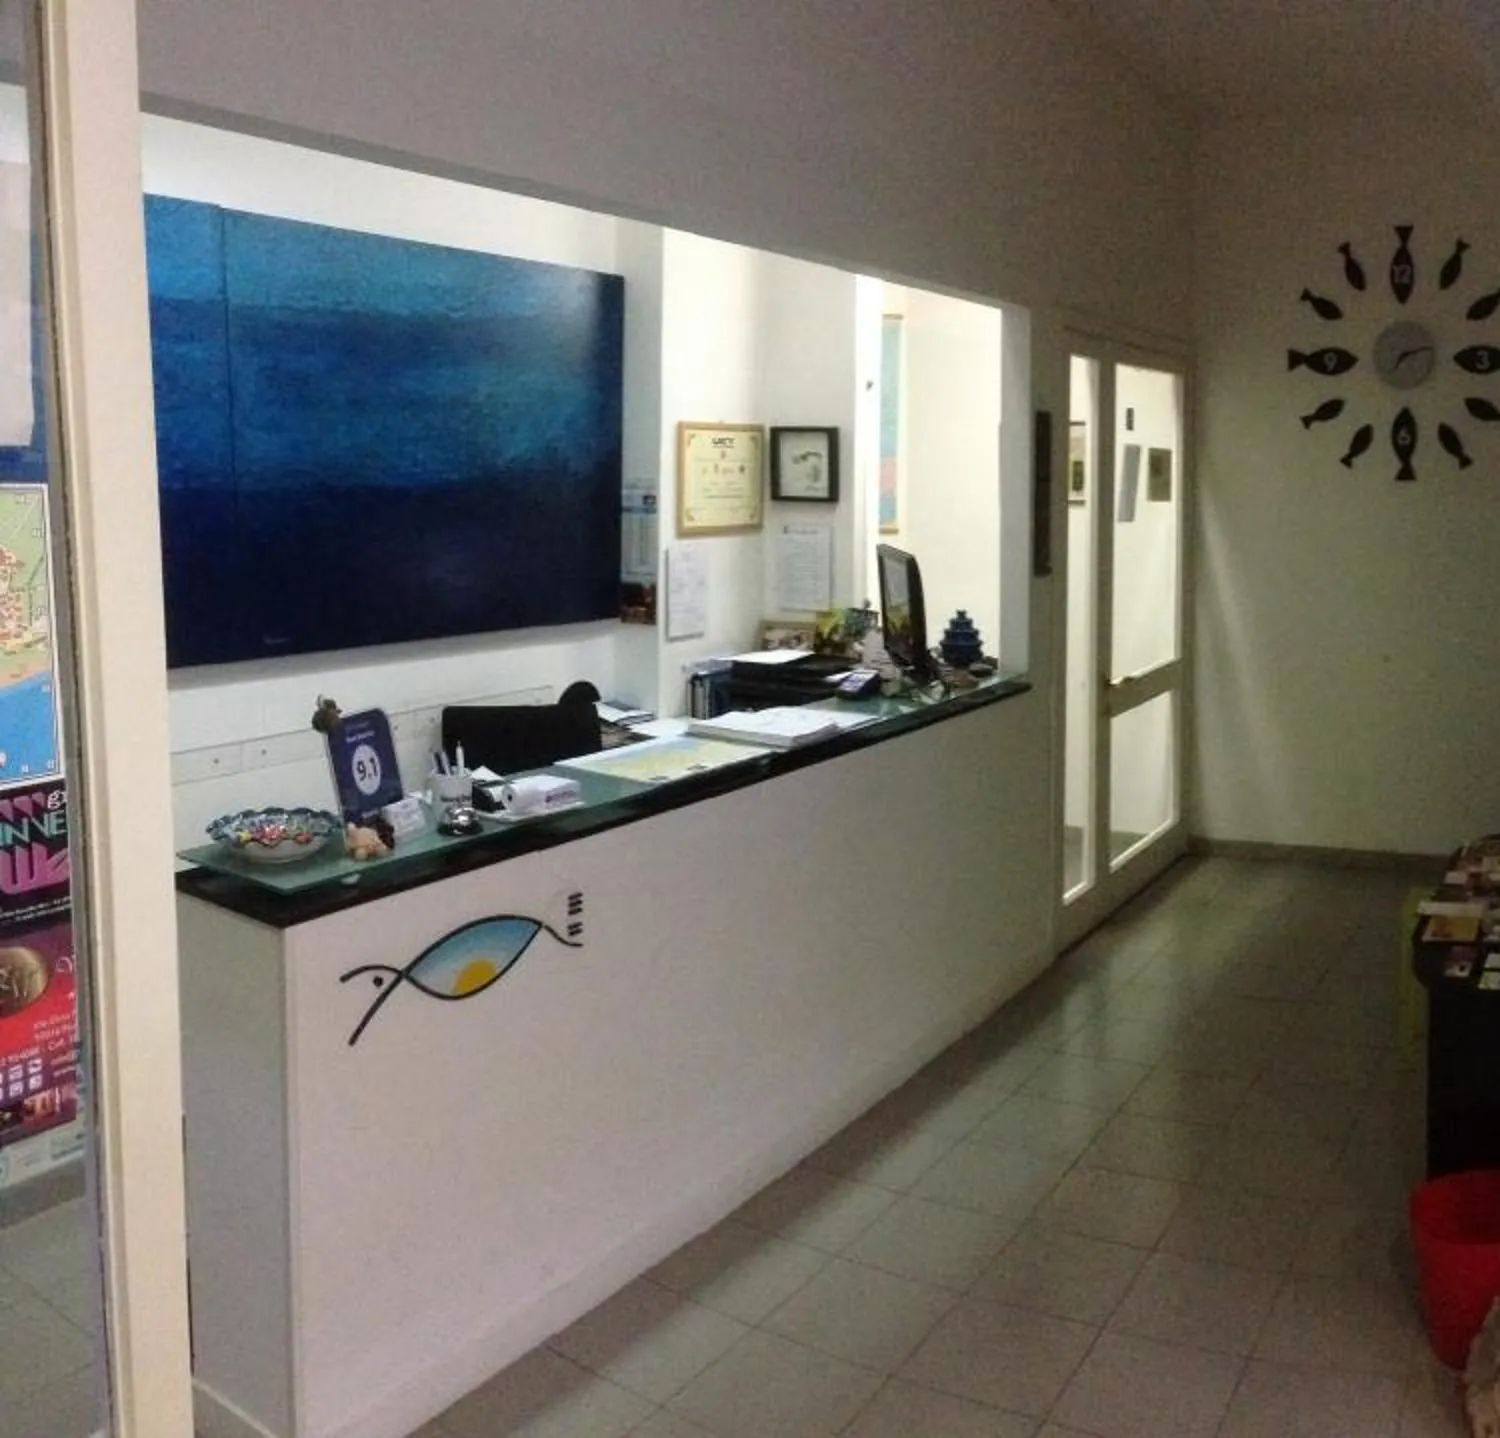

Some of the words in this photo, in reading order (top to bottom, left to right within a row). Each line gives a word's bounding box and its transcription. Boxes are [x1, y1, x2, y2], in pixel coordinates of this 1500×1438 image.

[1392, 263, 1412, 284] 12
[1323, 351, 1338, 371] 9
[1476, 350, 1490, 370] 3
[1396, 428, 1411, 445] 6
[356, 757, 378, 782] 9.1
